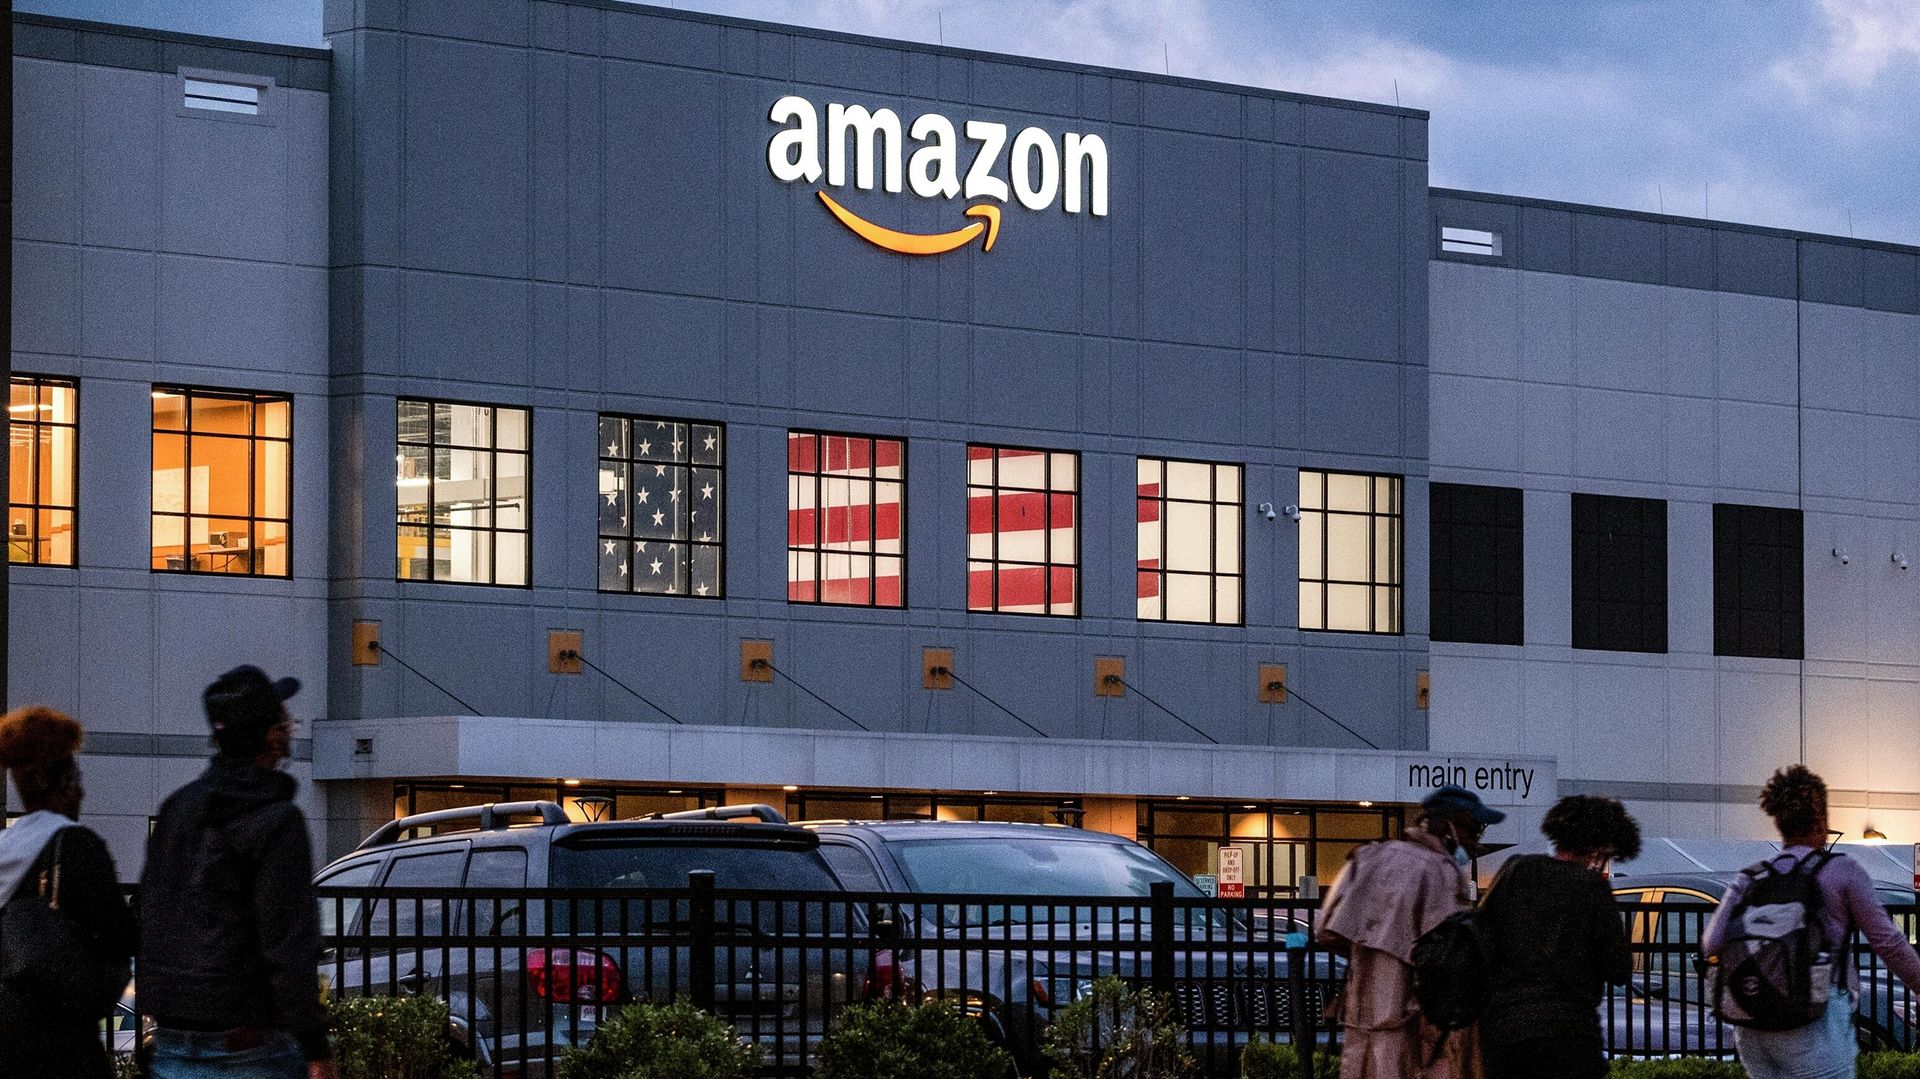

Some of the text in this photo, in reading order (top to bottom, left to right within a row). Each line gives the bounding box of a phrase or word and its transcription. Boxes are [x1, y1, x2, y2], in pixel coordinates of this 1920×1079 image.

[767, 96, 1108, 216] amazon
[1409, 758, 1534, 799] main entry
